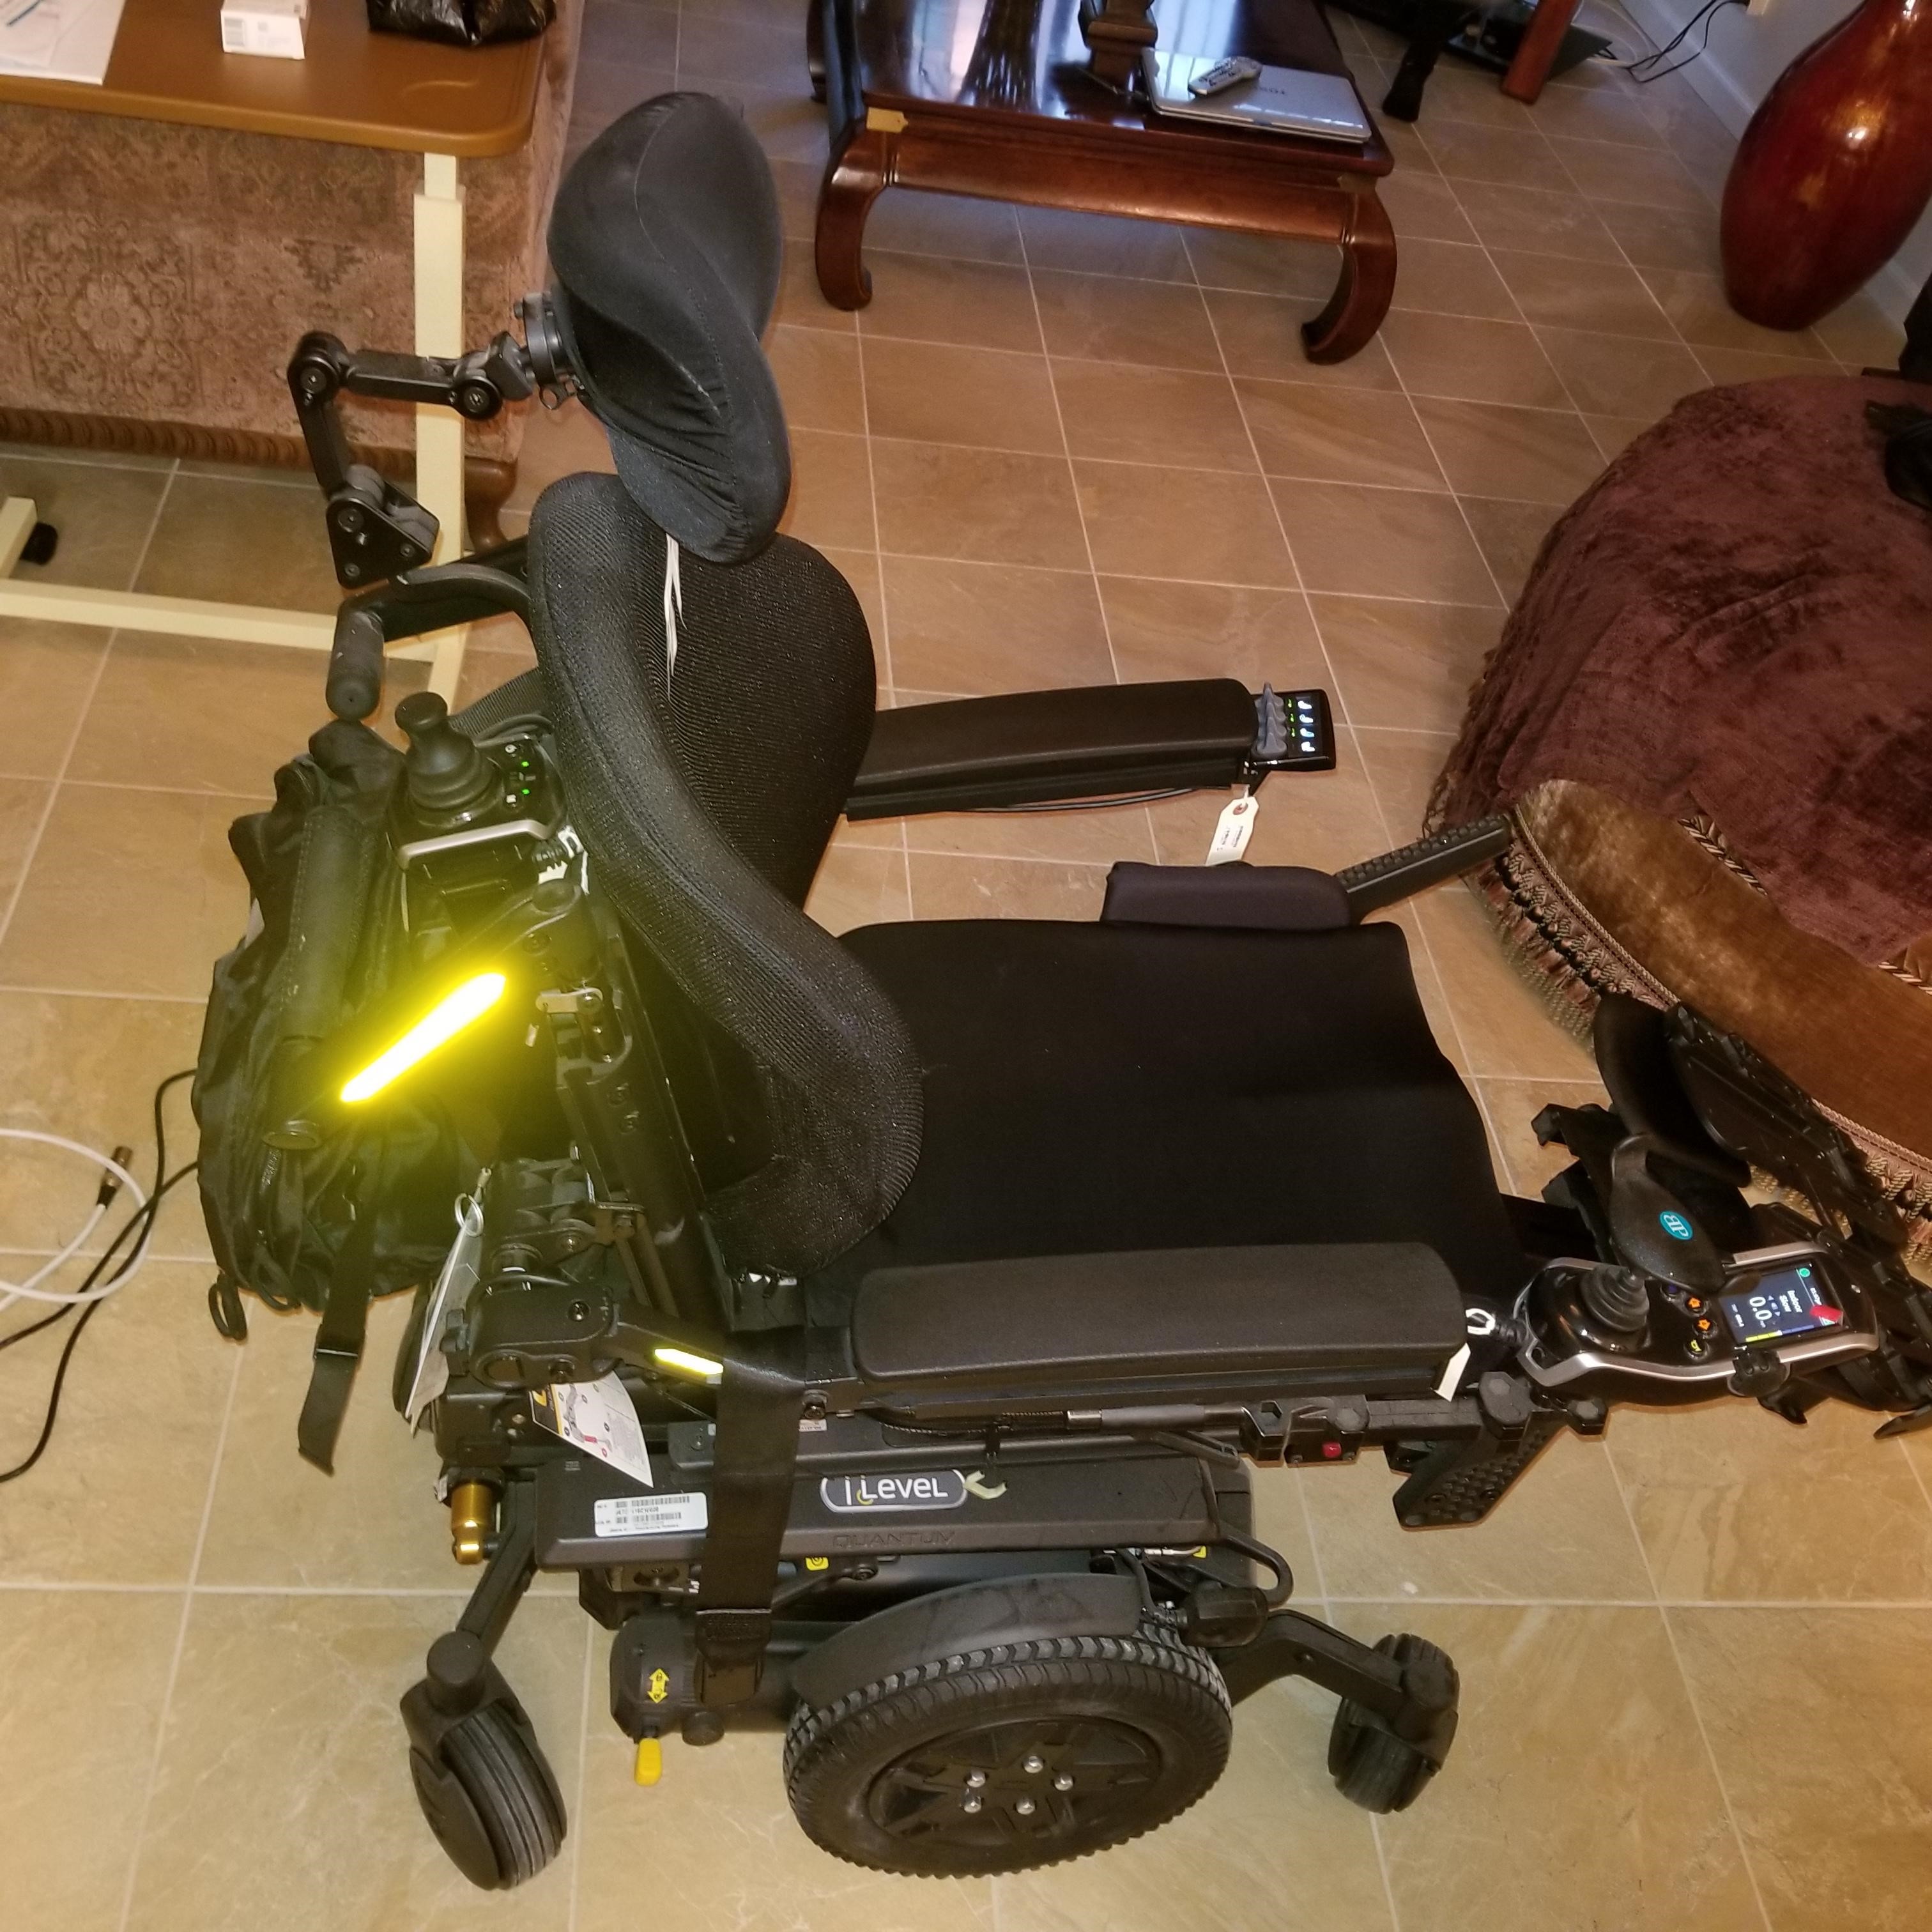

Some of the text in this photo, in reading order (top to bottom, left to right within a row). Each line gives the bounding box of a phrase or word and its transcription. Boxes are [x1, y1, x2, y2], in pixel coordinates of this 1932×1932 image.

[1749, 1296, 1772, 1321] 0.0
[1779, 1294, 1792, 1313] Slow
[1787, 1291, 1803, 1313] Indoor
[832, 1530, 956, 1549] QUANTUM
